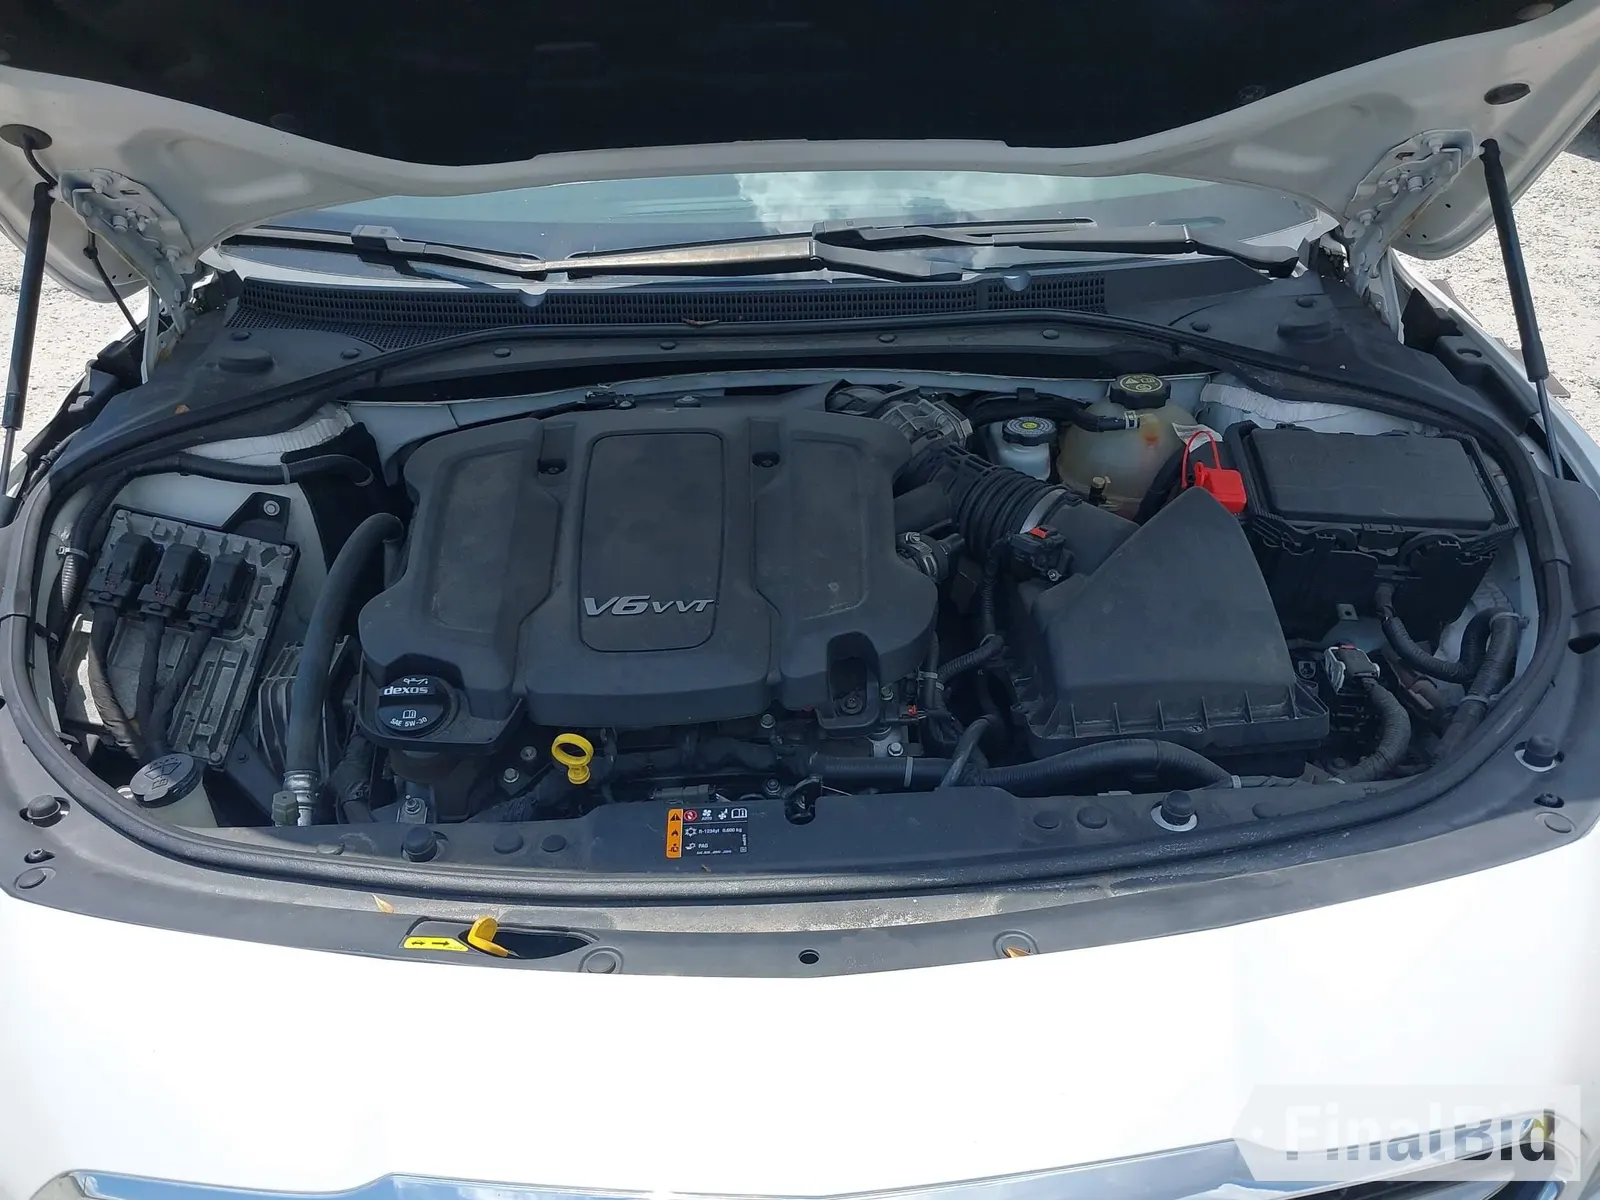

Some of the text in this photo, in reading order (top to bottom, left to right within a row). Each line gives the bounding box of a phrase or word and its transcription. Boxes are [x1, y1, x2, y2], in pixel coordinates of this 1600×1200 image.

[584, 594, 715, 616] V6 VVT
[384, 686, 429, 696] dexos
[390, 716, 428, 728] SAE 5W-30
